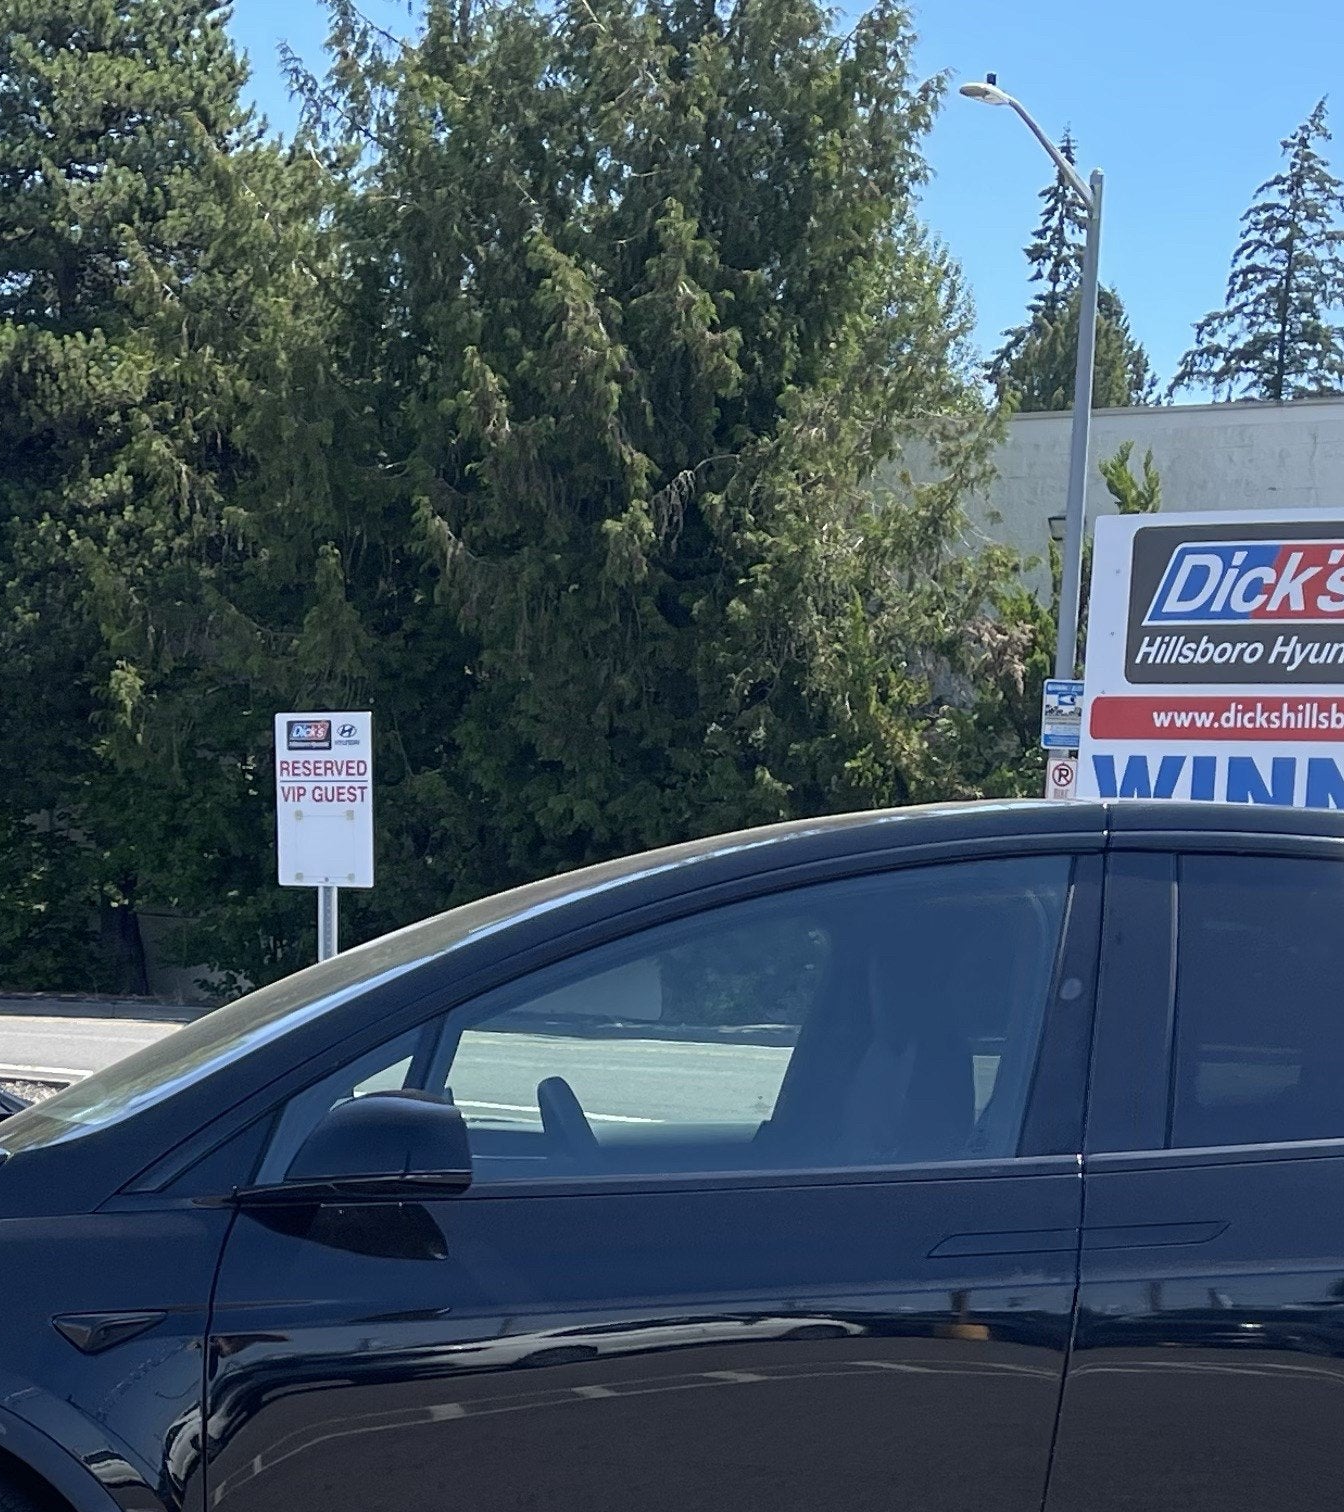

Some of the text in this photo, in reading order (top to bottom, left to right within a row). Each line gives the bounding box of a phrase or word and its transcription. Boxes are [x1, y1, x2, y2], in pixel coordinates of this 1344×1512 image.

[1135, 636, 1264, 664] Hillsboro
[280, 760, 368, 777] RESERVED
[281, 786, 368, 803] VIP GUEST
